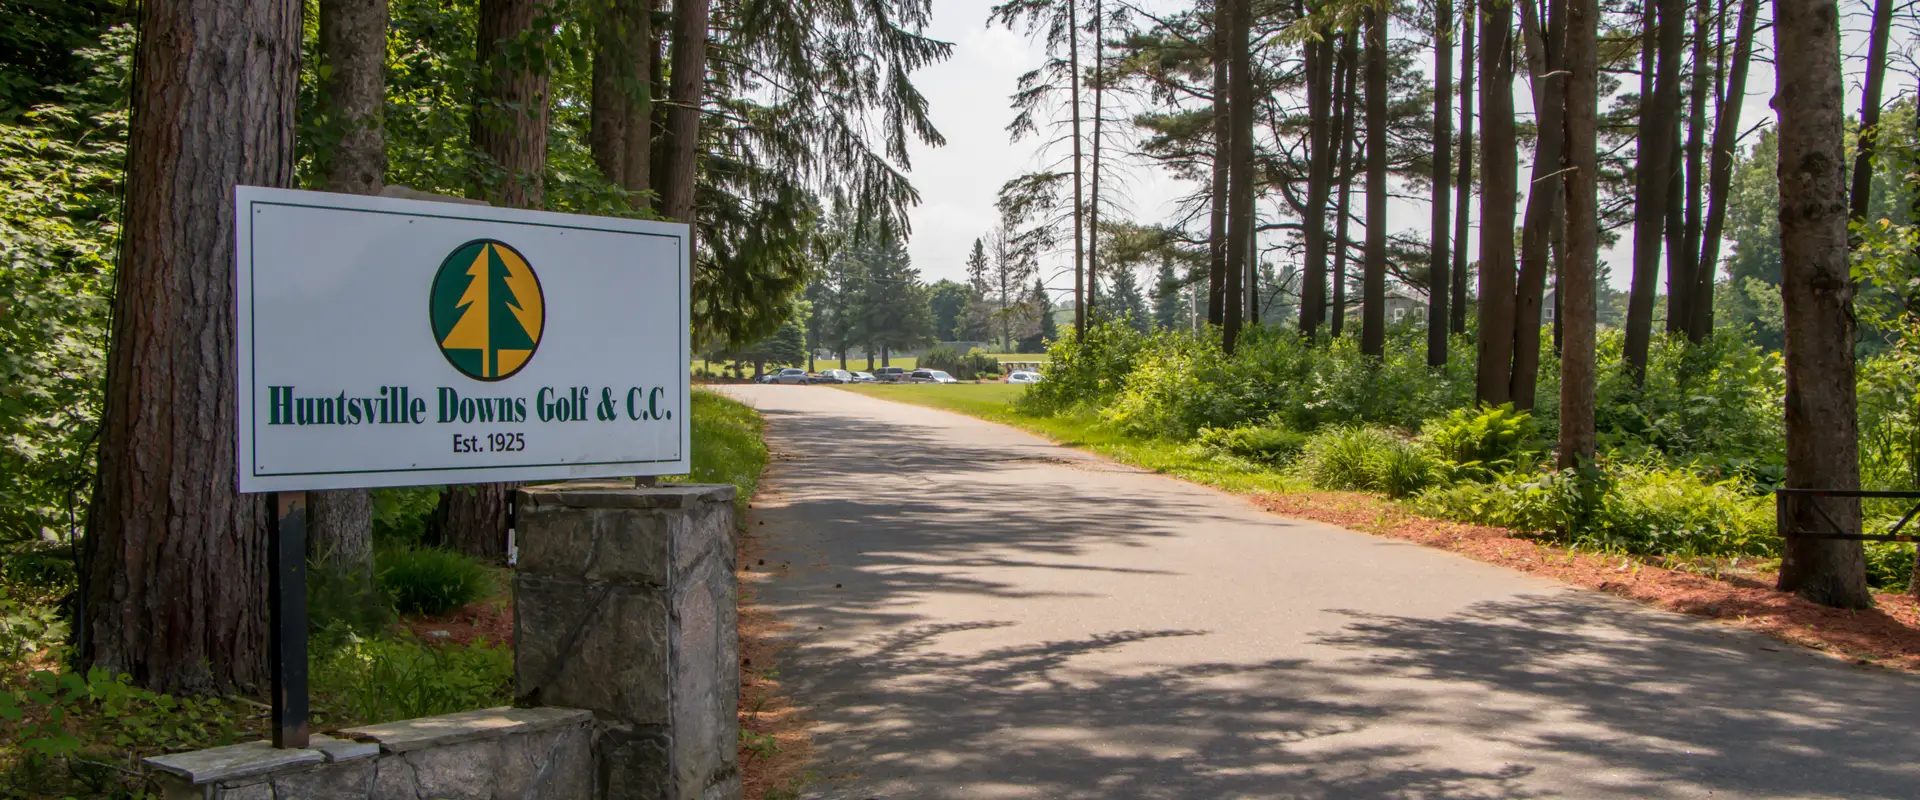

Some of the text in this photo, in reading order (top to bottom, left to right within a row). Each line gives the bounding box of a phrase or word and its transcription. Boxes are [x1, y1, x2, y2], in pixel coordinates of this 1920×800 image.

[267, 385, 672, 426] Huntsville Downs Golf & C.C.
[453, 432, 526, 453] Est. 1925
